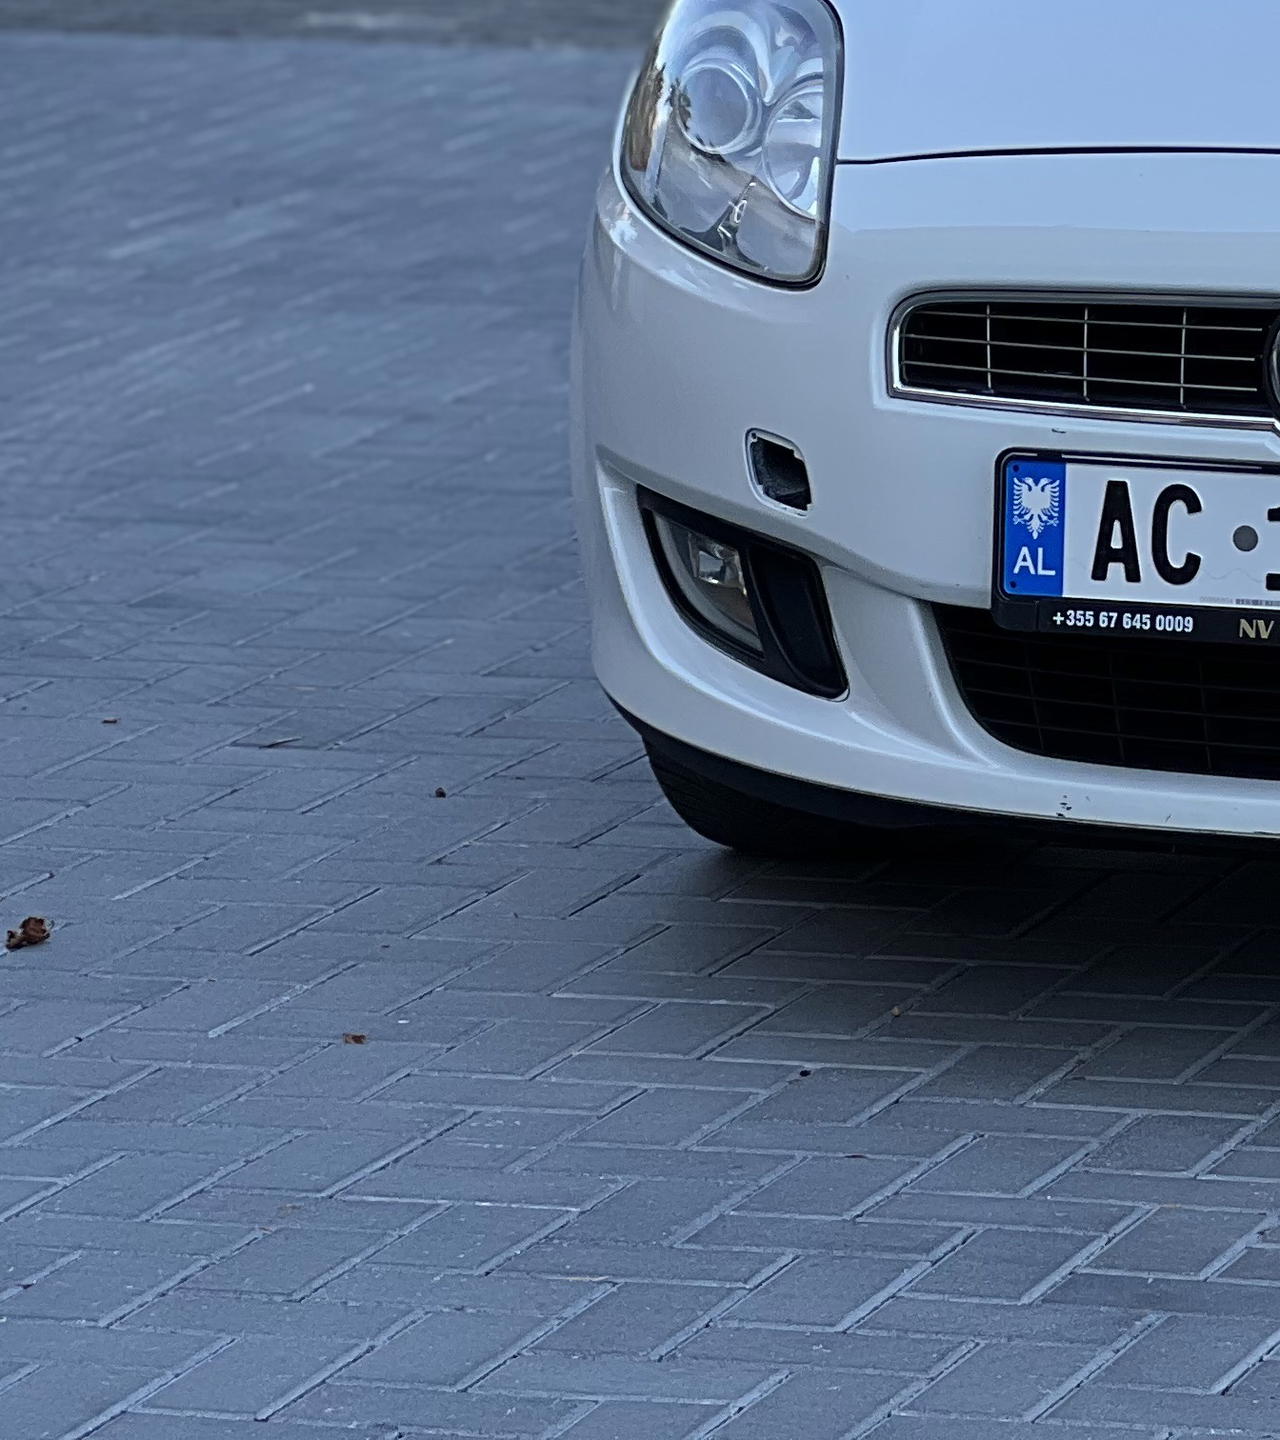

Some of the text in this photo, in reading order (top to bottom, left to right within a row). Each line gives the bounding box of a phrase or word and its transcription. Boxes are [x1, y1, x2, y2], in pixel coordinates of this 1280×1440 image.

[1091, 479, 1203, 586] AC
[1013, 546, 1056, 577] AL
[1052, 609, 1194, 633] +355 67 645 0009
[1239, 618, 1275, 639] NV
